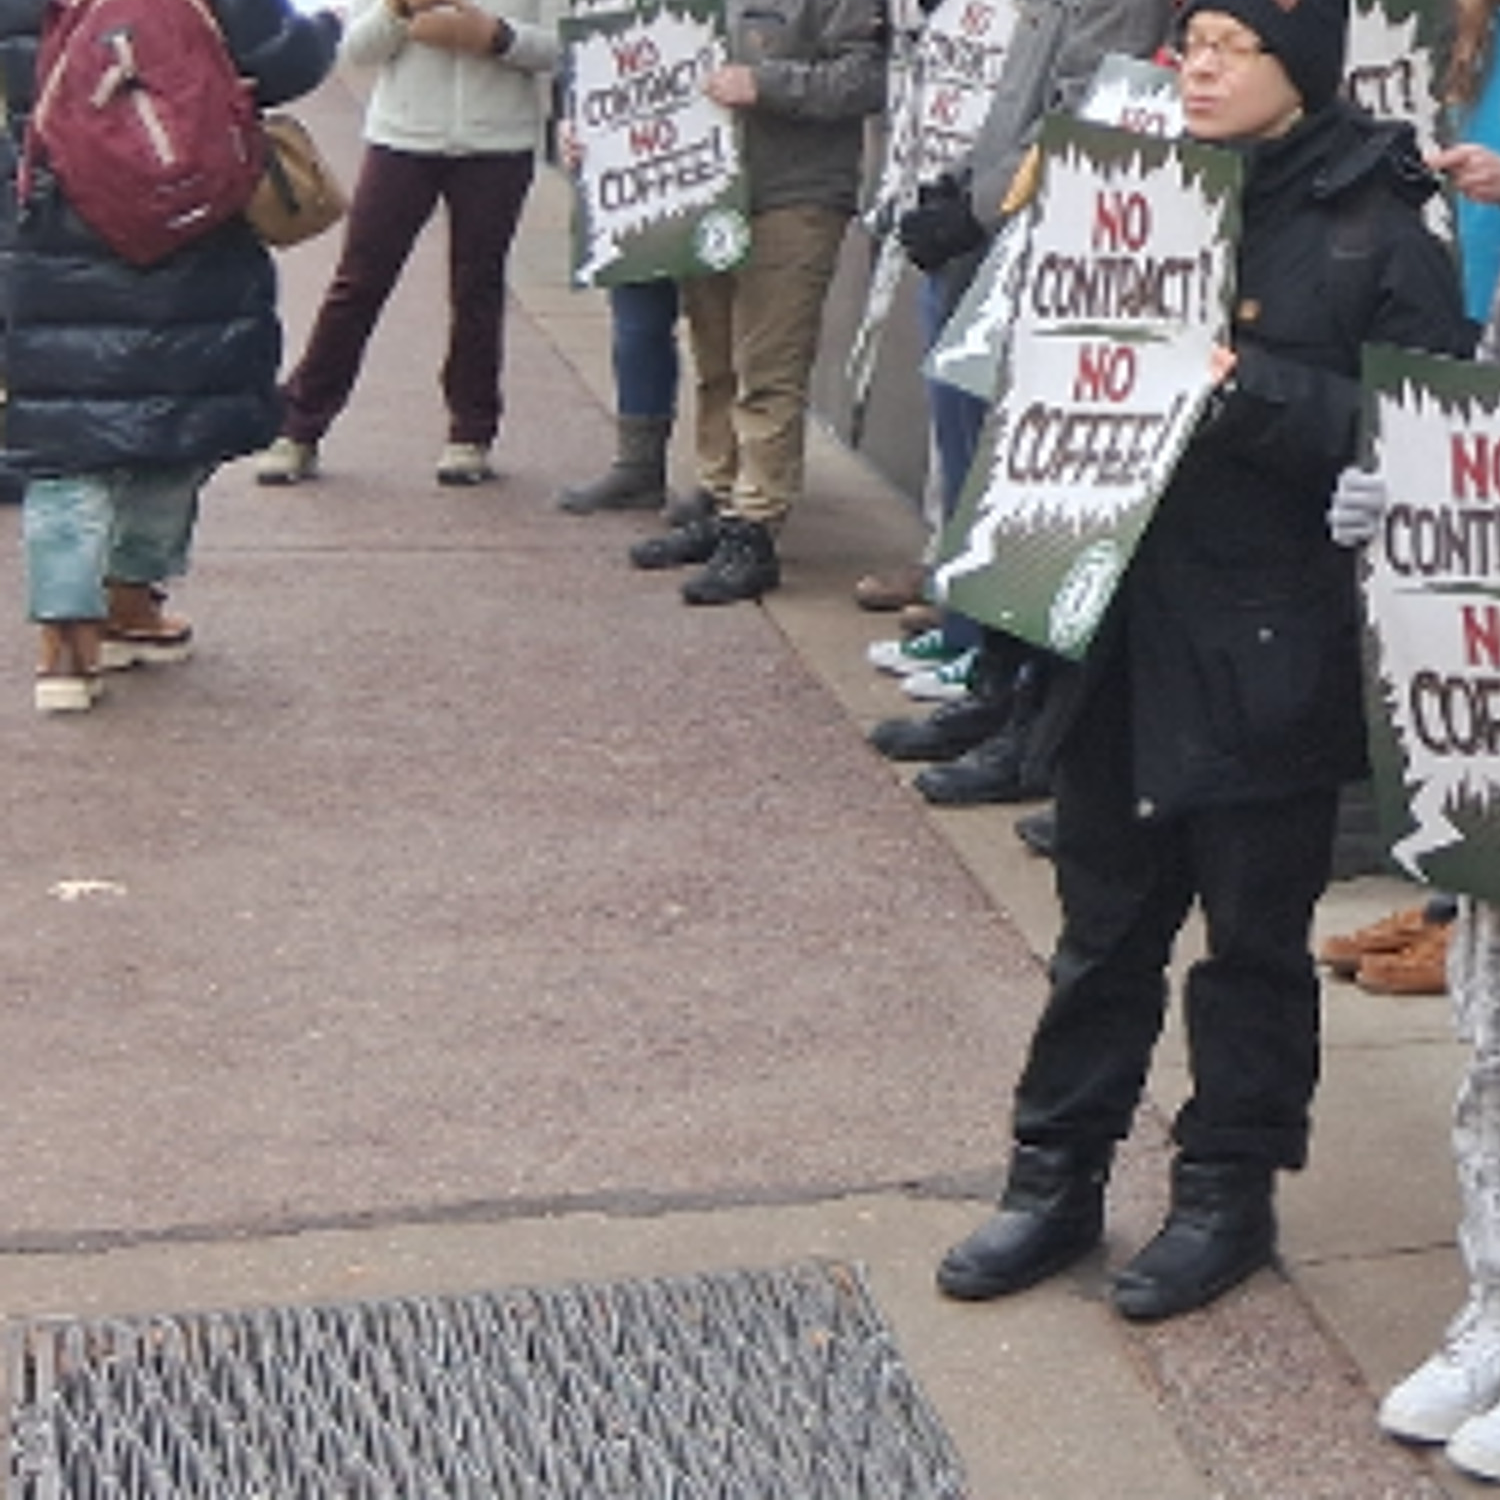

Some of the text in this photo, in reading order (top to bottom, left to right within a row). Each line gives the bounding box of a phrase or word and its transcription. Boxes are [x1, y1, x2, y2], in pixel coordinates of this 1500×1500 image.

[612, 37, 660, 77] NO
[629, 120, 678, 154] NO
[1092, 190, 1152, 252] NO
[1032, 252, 1214, 324] CONTRACT?
[1073, 343, 1137, 403] NO
